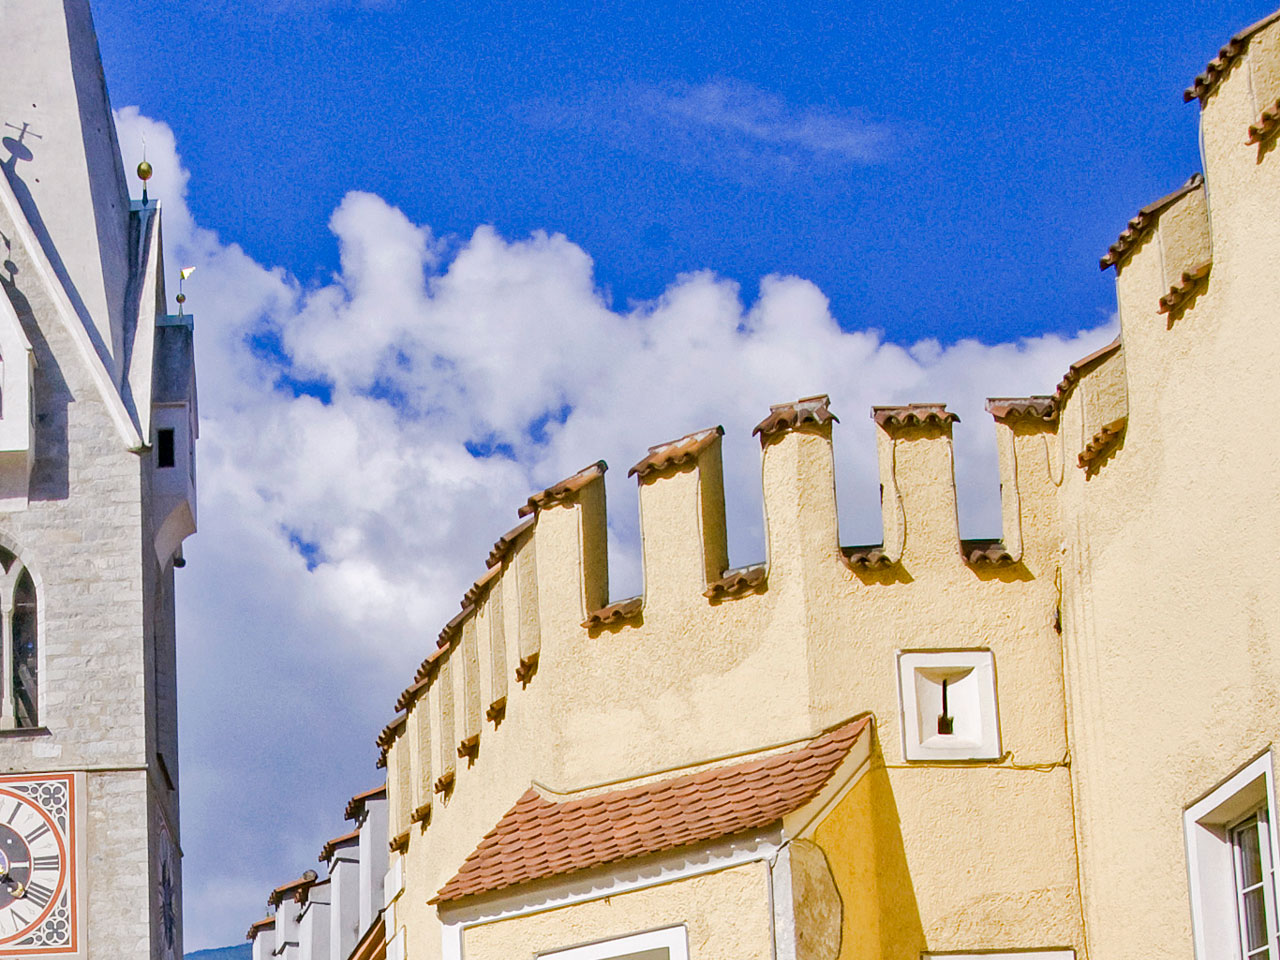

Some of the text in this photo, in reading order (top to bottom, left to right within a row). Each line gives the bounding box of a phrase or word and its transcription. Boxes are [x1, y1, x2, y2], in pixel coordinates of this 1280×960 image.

[7, 802, 23, 825] I
[24, 821, 51, 845] II
[33, 854, 60, 871] III
